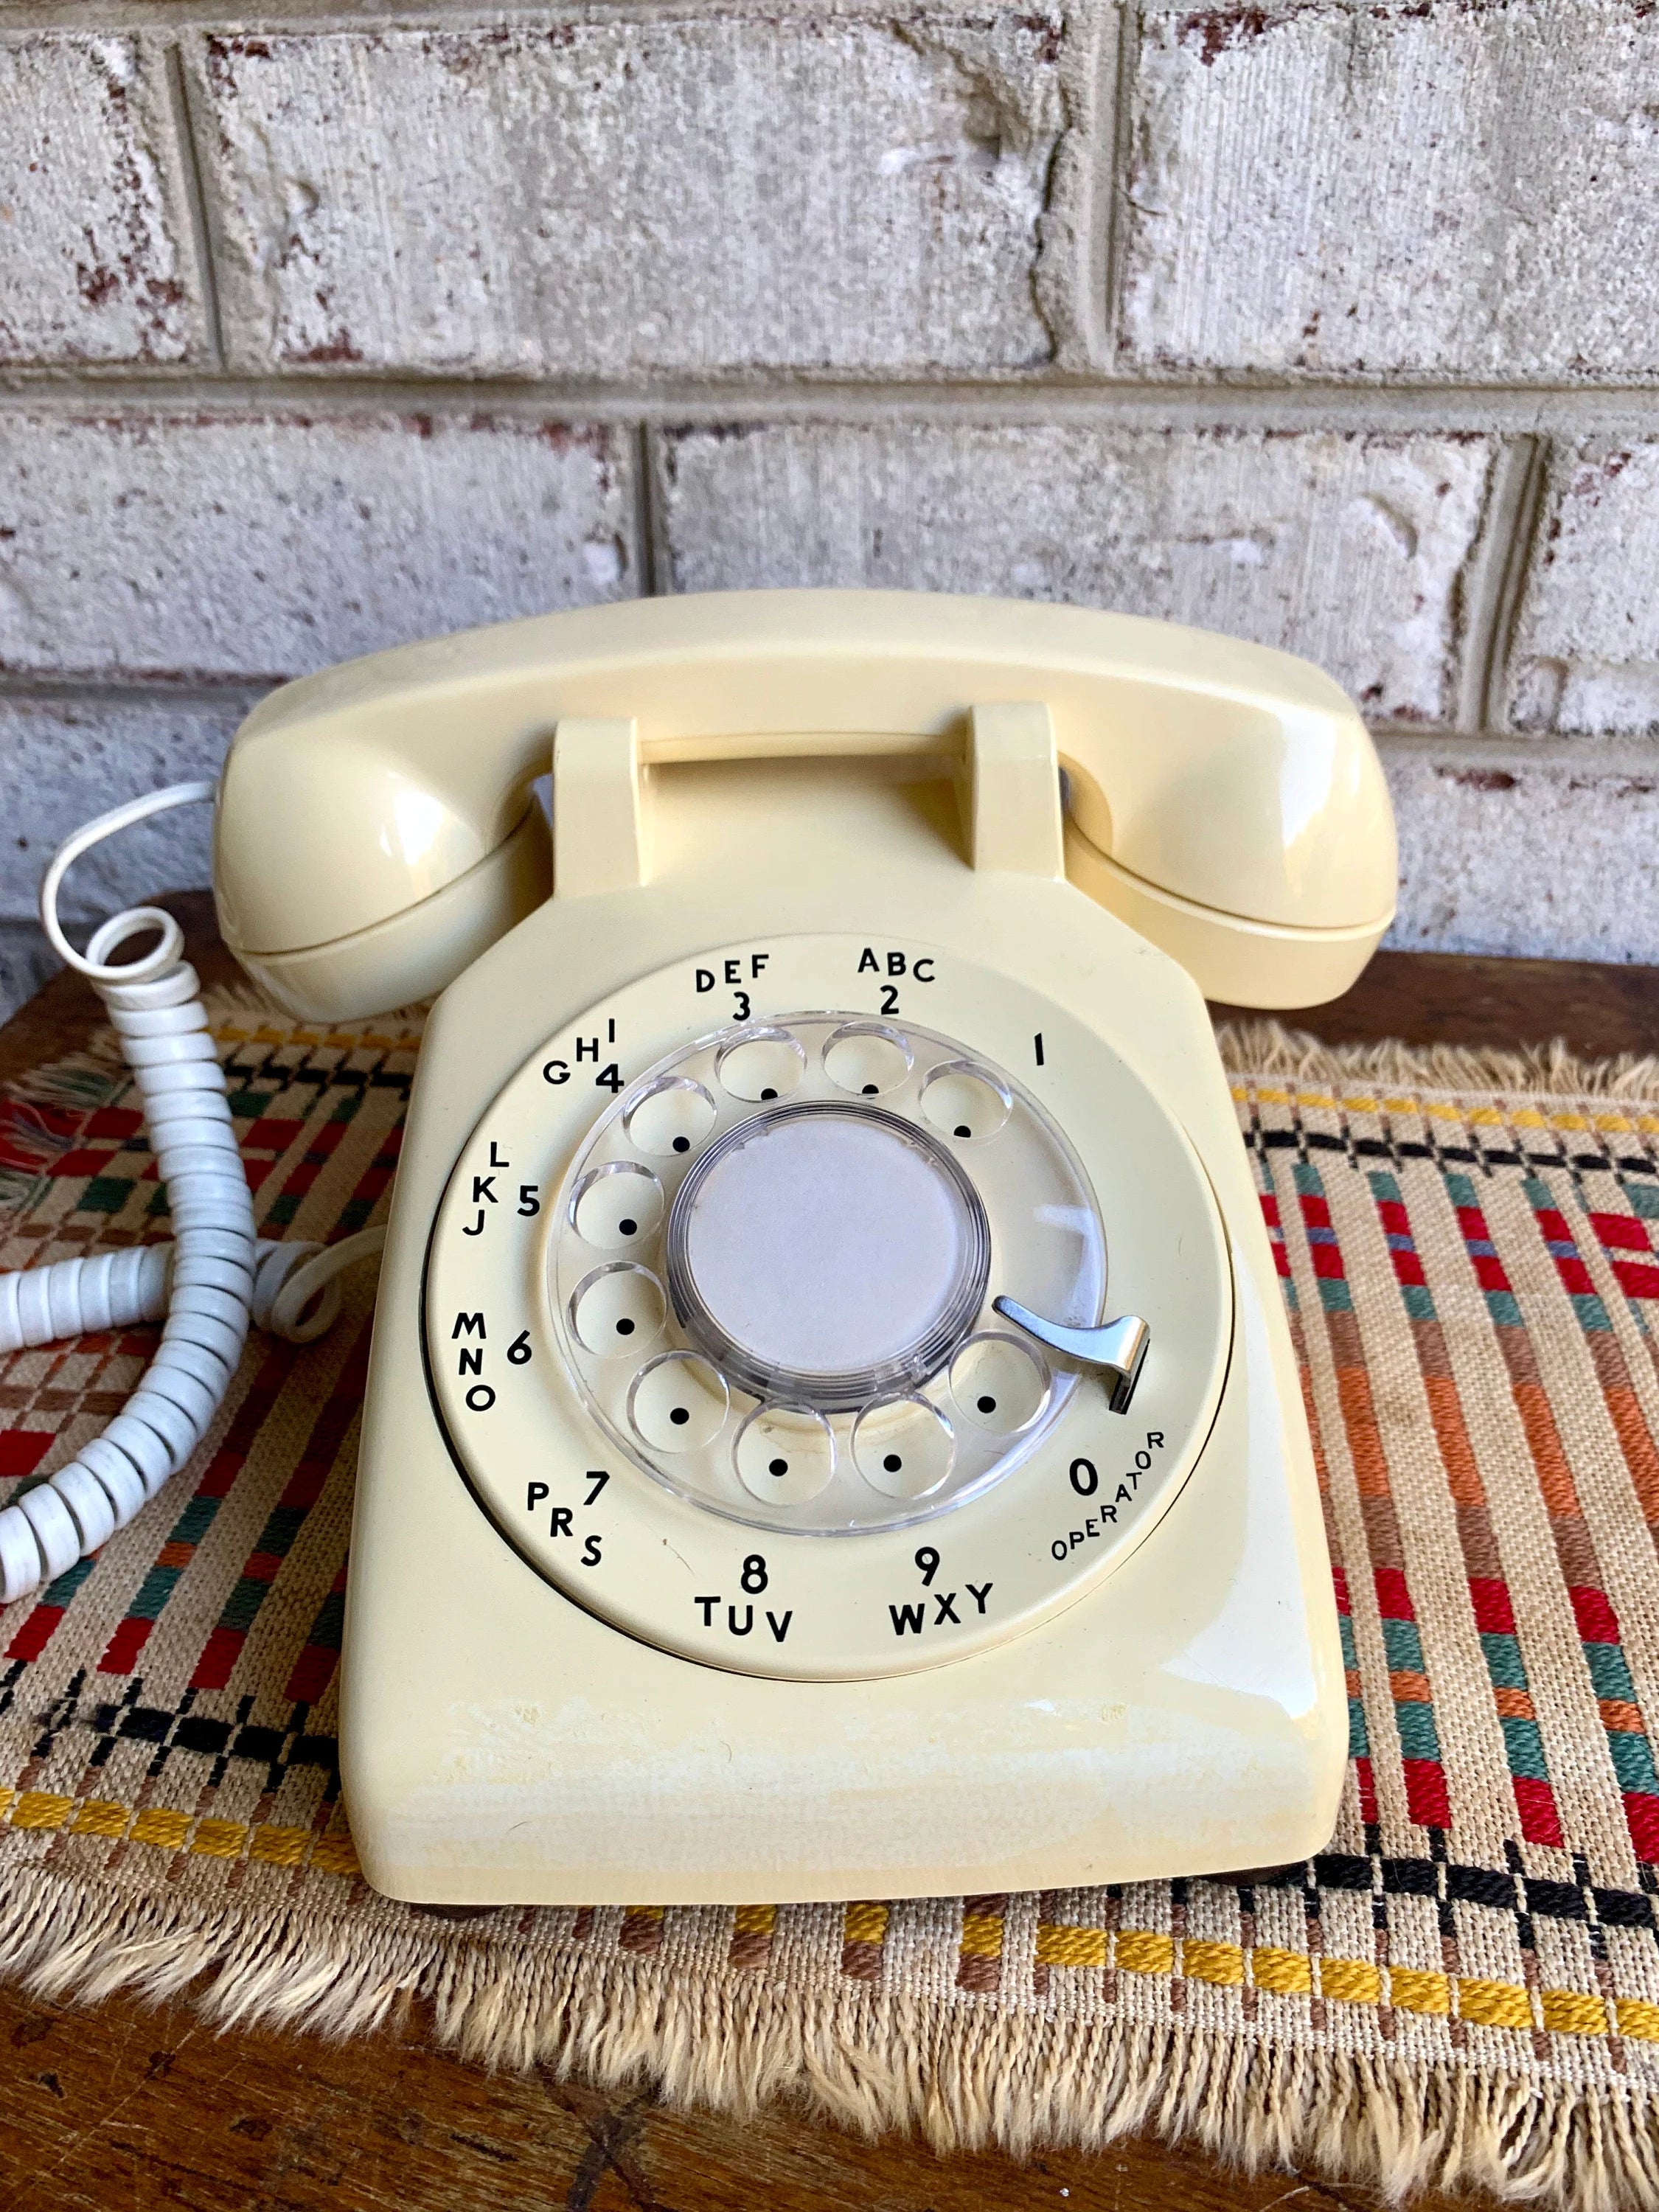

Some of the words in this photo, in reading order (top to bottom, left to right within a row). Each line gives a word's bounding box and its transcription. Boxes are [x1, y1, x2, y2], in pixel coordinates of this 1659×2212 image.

[695, 953, 770, 994] DEF
[857, 947, 936, 984] ABC
[731, 990, 751, 1022] 3
[879, 984, 900, 1016] 2
[542, 1018, 616, 1086] GHI
[594, 1062, 625, 1095] 4
[516, 1184, 541, 1218] 5
[451, 1311, 497, 1413] MNO
[506, 1329, 533, 1366] 6
[582, 1470, 611, 1506] 7
[1050, 1430, 1165, 1562] OPERATOR
[526, 1481, 603, 1568] PRS
[740, 1553, 769, 1596] 8
[914, 1545, 941, 1587] 9
[693, 1595, 793, 1644] TUV
[888, 1582, 995, 1637] WXY
